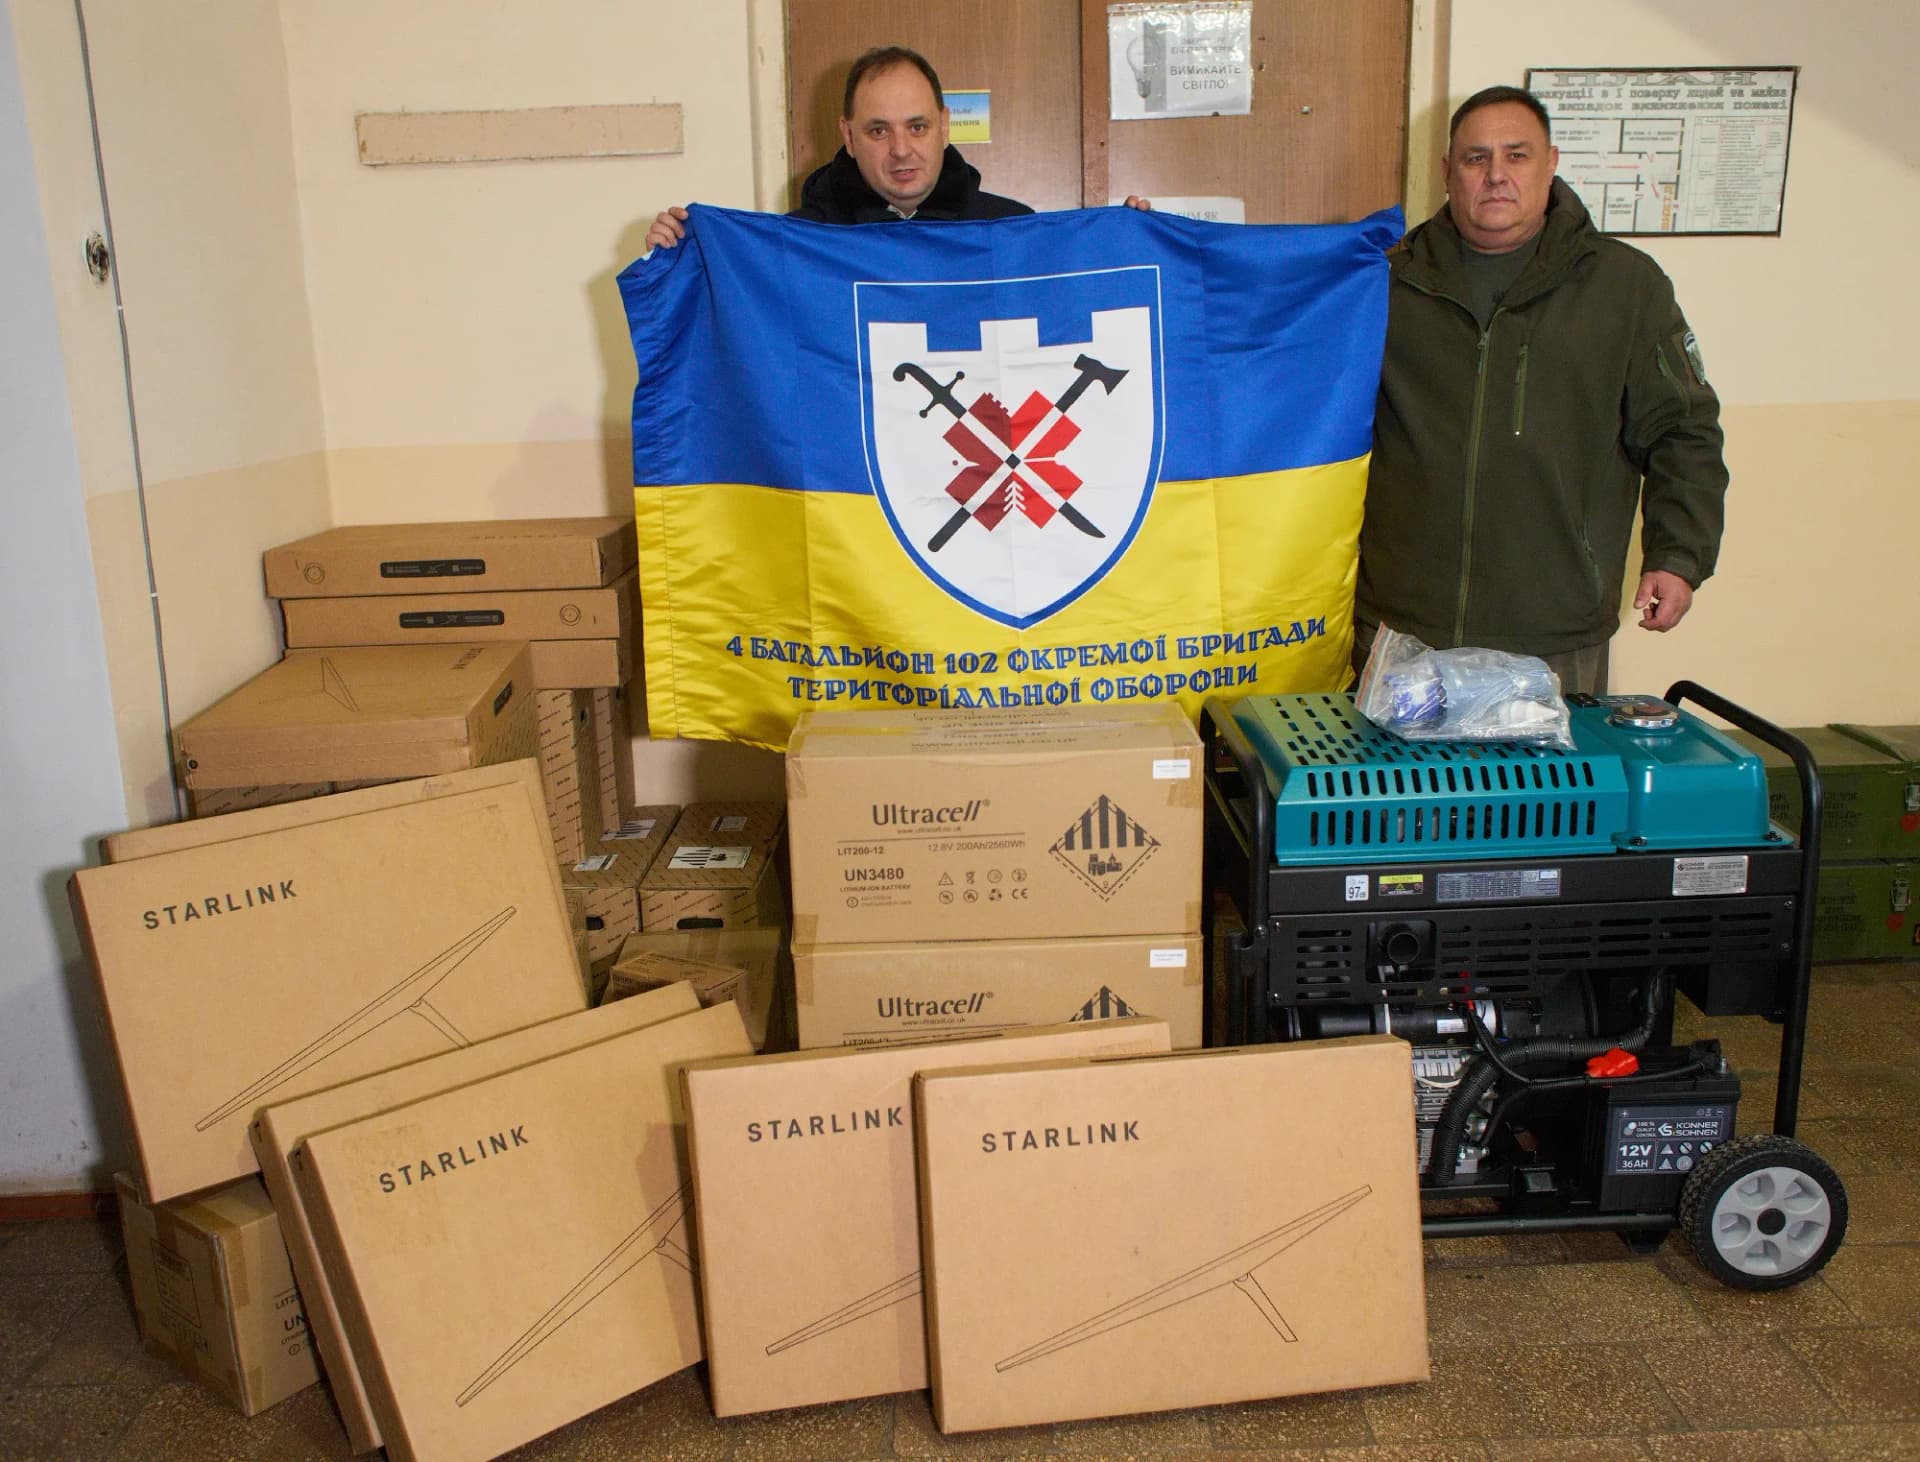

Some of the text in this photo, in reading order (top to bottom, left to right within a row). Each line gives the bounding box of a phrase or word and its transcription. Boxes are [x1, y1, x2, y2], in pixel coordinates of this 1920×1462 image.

[1551, 71, 1758, 87] ПЛАН
[726, 615, 1327, 675] 4 БАТАЛЬЙОН 102 ОКРЕМОЇ БРИГАДИ
[787, 662, 1259, 709] ТЕРИТОРІАЛЬНОЇ ОБОРОНИ
[872, 800, 982, 826] Ultracell
[837, 846, 885, 857] LIT200-12
[844, 867, 905, 882] UN3480
[143, 879, 297, 930] STARLINK
[1348, 886, 1361, 899] 97
[877, 992, 985, 1018] Ultracell
[747, 1106, 904, 1143] STARLINK
[981, 1120, 1140, 1153] STARLINK
[379, 1125, 529, 1193] STARLINK
[1619, 1144, 1652, 1157] 12V
